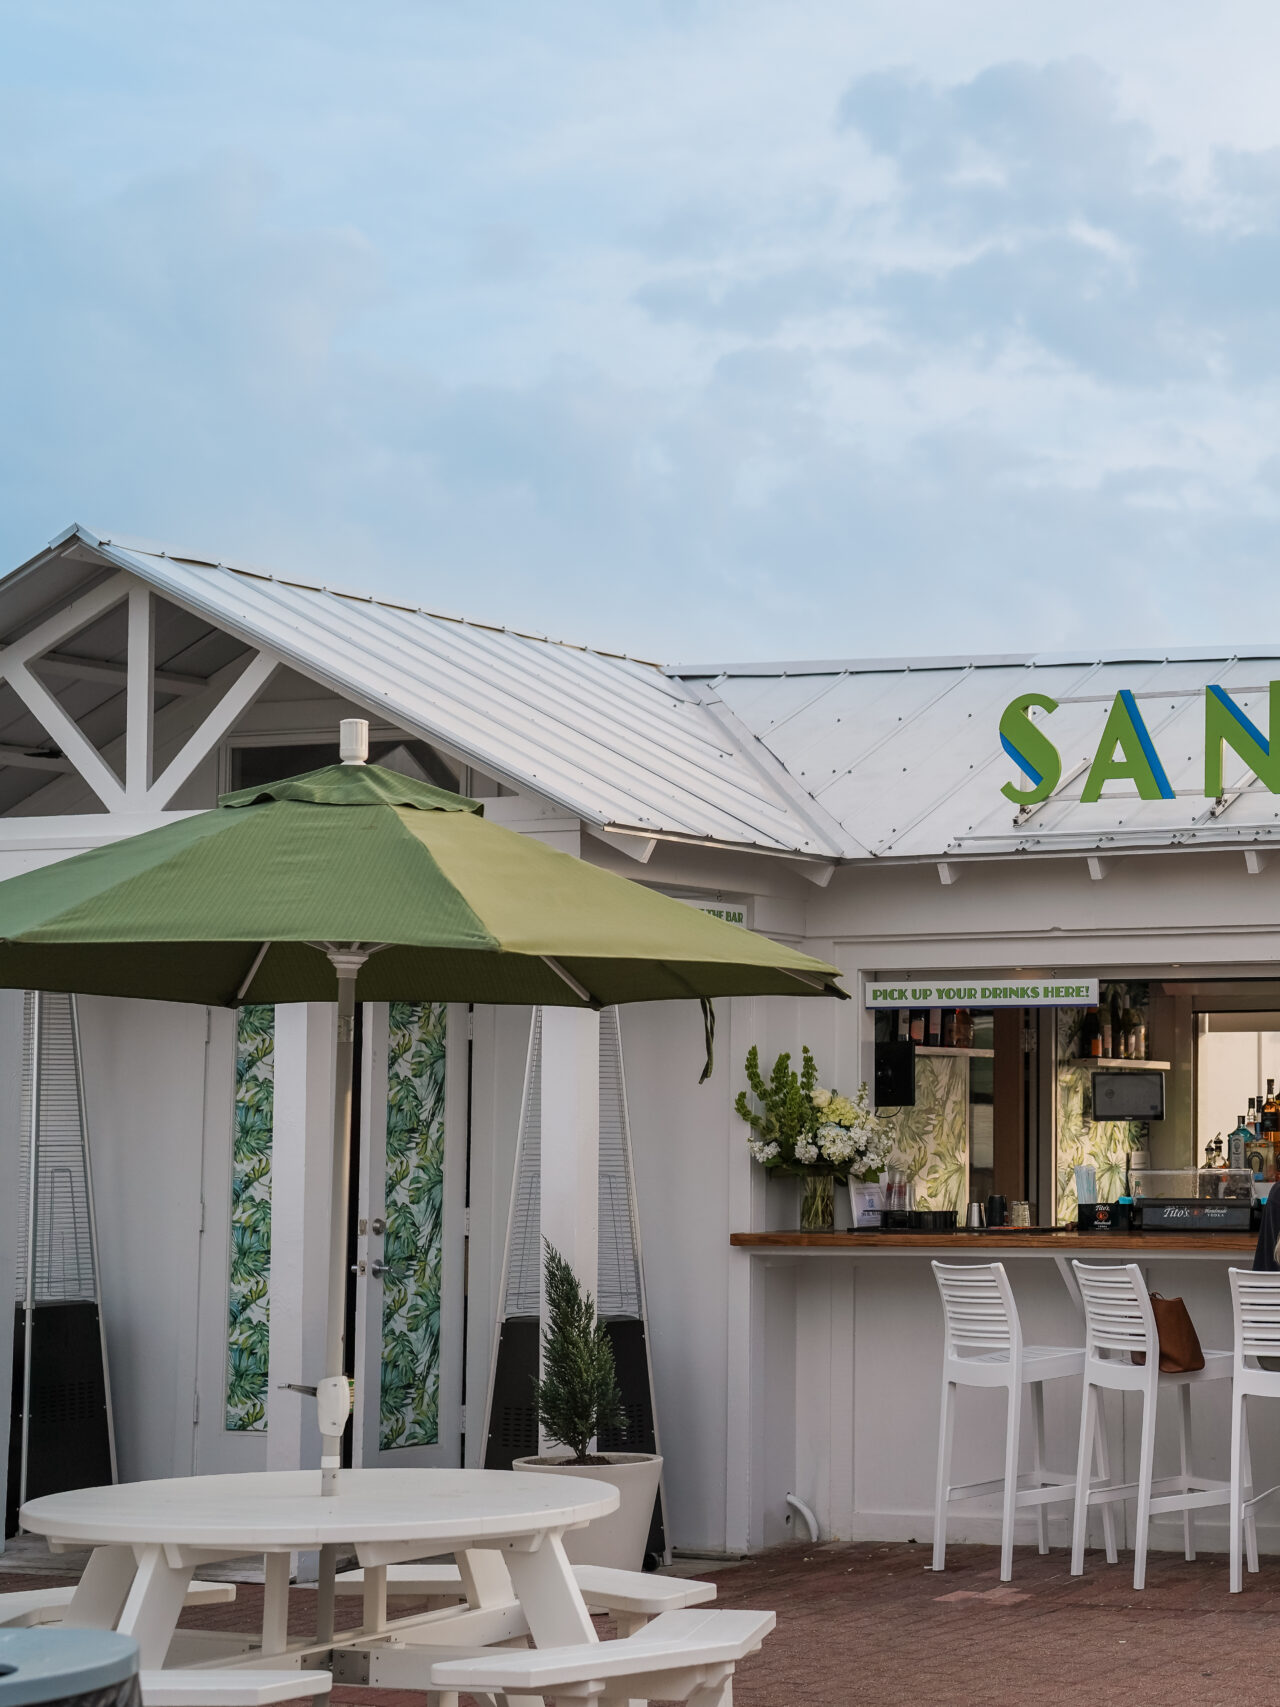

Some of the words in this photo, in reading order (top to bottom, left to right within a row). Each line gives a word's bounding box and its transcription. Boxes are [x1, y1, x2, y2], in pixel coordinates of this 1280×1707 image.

[725, 911, 744, 923] BAR
[872, 989, 908, 1001] PICK
[911, 988, 933, 1000] UP
[935, 987, 978, 1000] YOUR
[980, 986, 1040, 999] DRINKS
[1043, 985, 1090, 998] HERE!
[1163, 1206, 1190, 1218] Tito's
